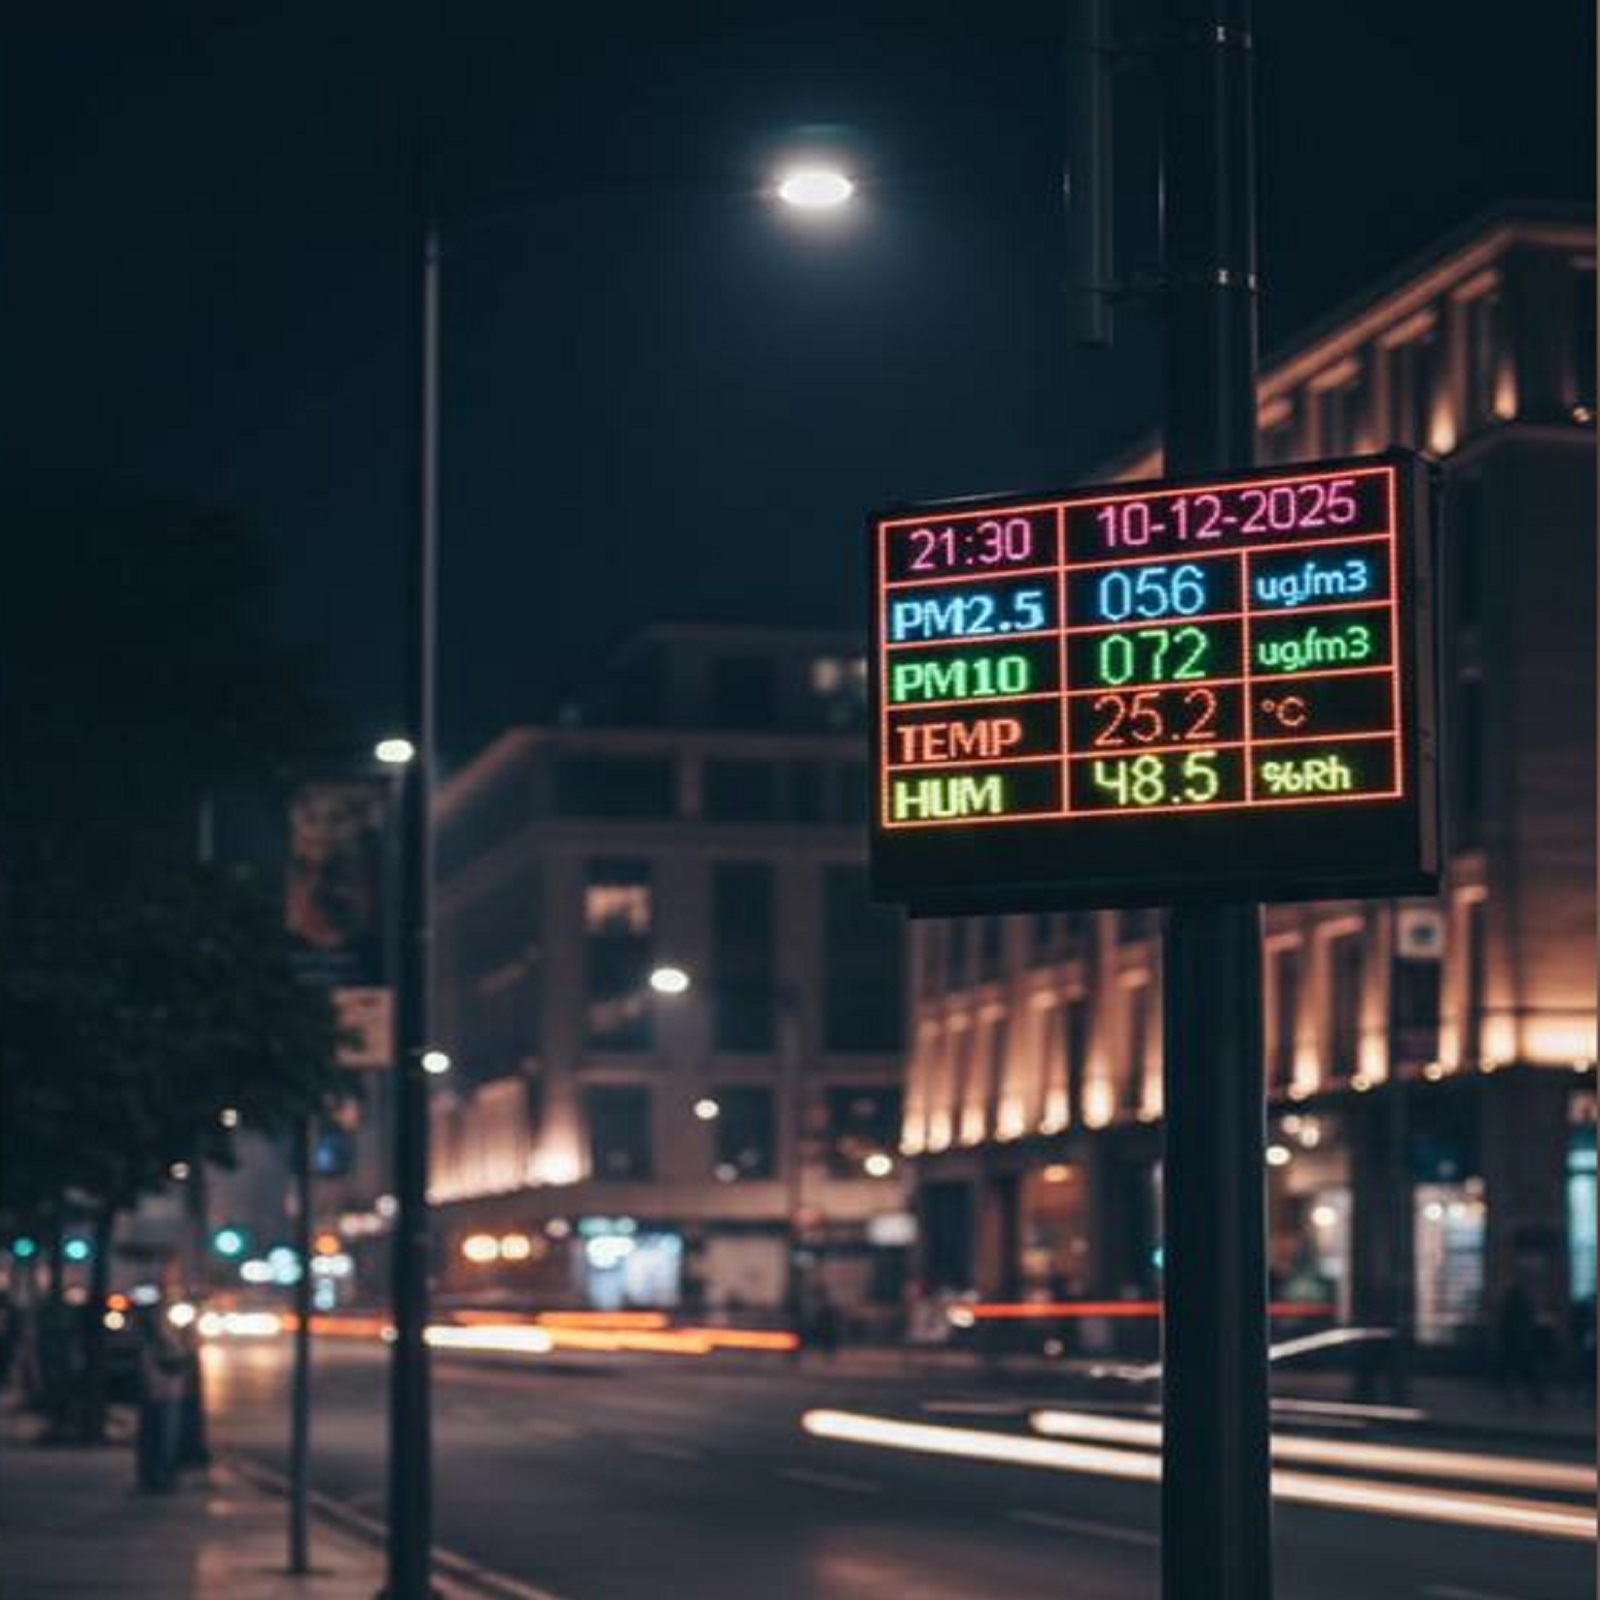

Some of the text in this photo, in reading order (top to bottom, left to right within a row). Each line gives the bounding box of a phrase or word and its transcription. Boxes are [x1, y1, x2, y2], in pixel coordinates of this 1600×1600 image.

[910, 481, 1356, 570] 21:30 10-12-2025
[894, 591, 1044, 640] PM2.5
[1100, 566, 1205, 621] 056
[893, 655, 1029, 702] PM10
[1099, 626, 1208, 686] 072
[897, 719, 1022, 762] TEMP
[1094, 688, 1217, 746] 25.2
[895, 751, 1351, 820] HUM 48.5 %Rh
